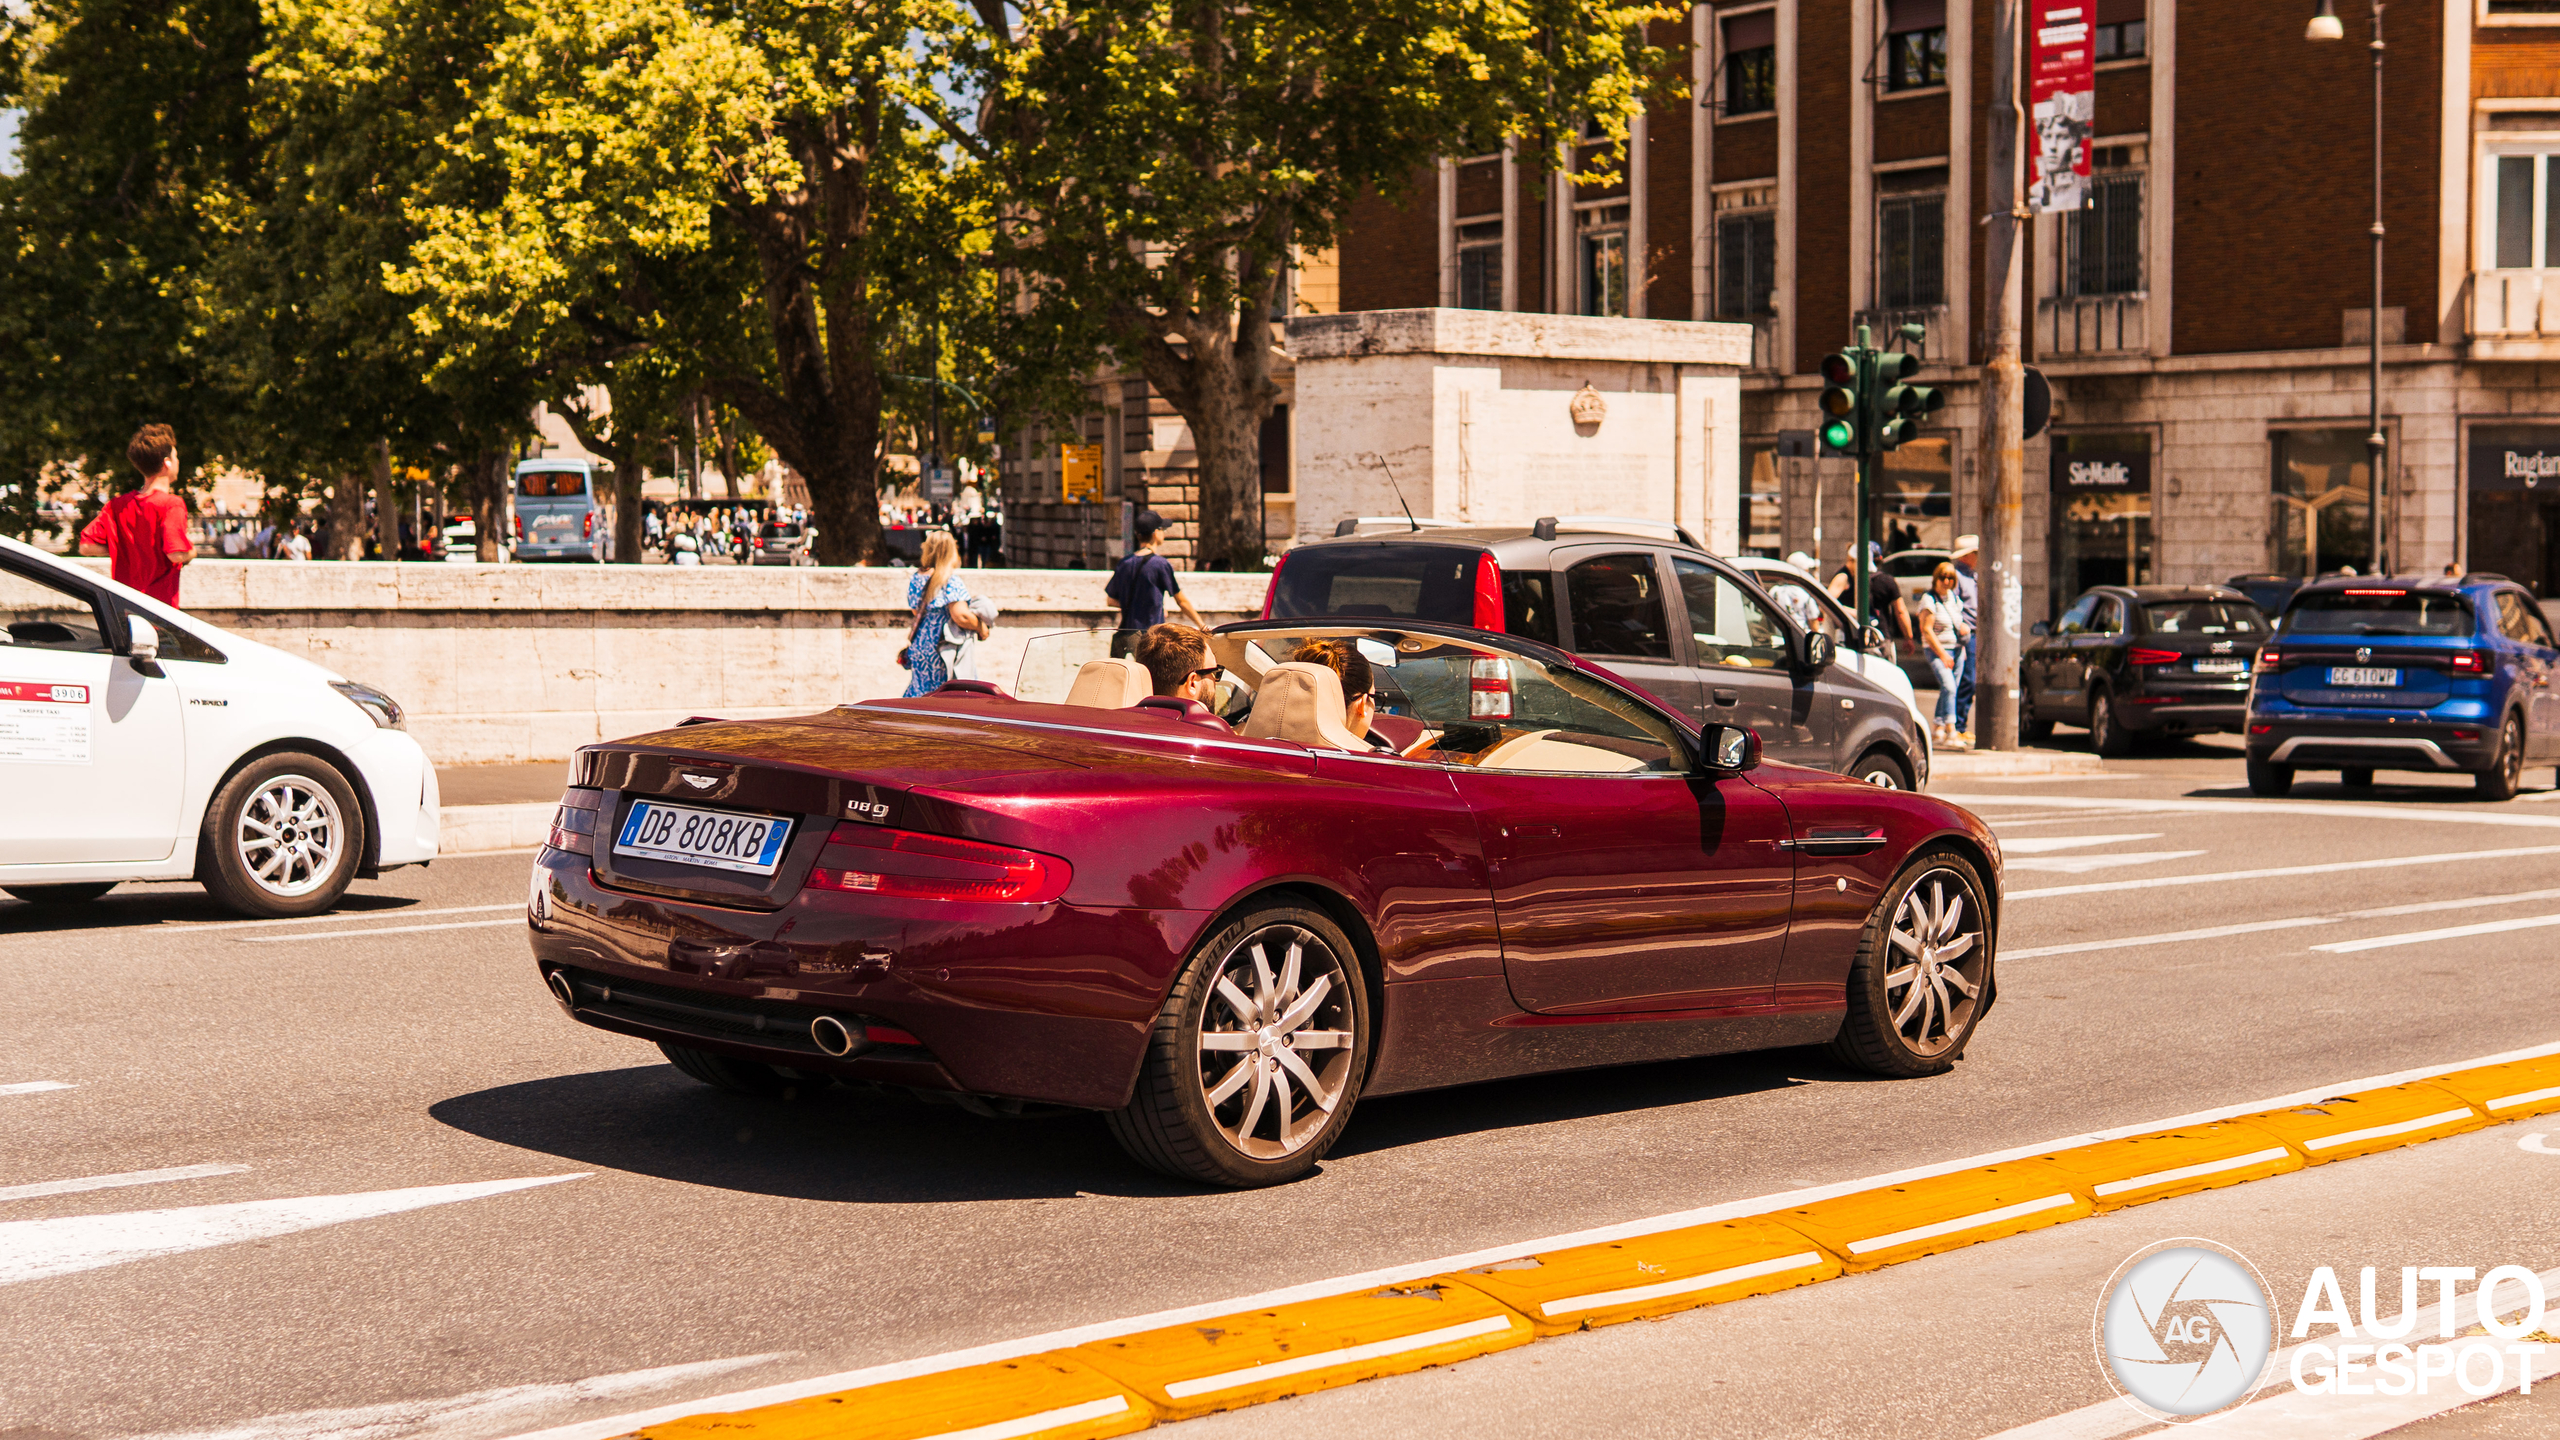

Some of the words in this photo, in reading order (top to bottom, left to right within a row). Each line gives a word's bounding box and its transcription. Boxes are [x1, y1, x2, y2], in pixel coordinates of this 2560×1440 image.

[2069, 462, 2129, 484] SieMatic
[54, 688, 84, 699] 3906
[638, 809, 677, 845] DB
[678, 814, 766, 857] 808KB
[682, 856, 700, 864] MARTIN
[1192, 920, 1244, 1001] MICHELIN
